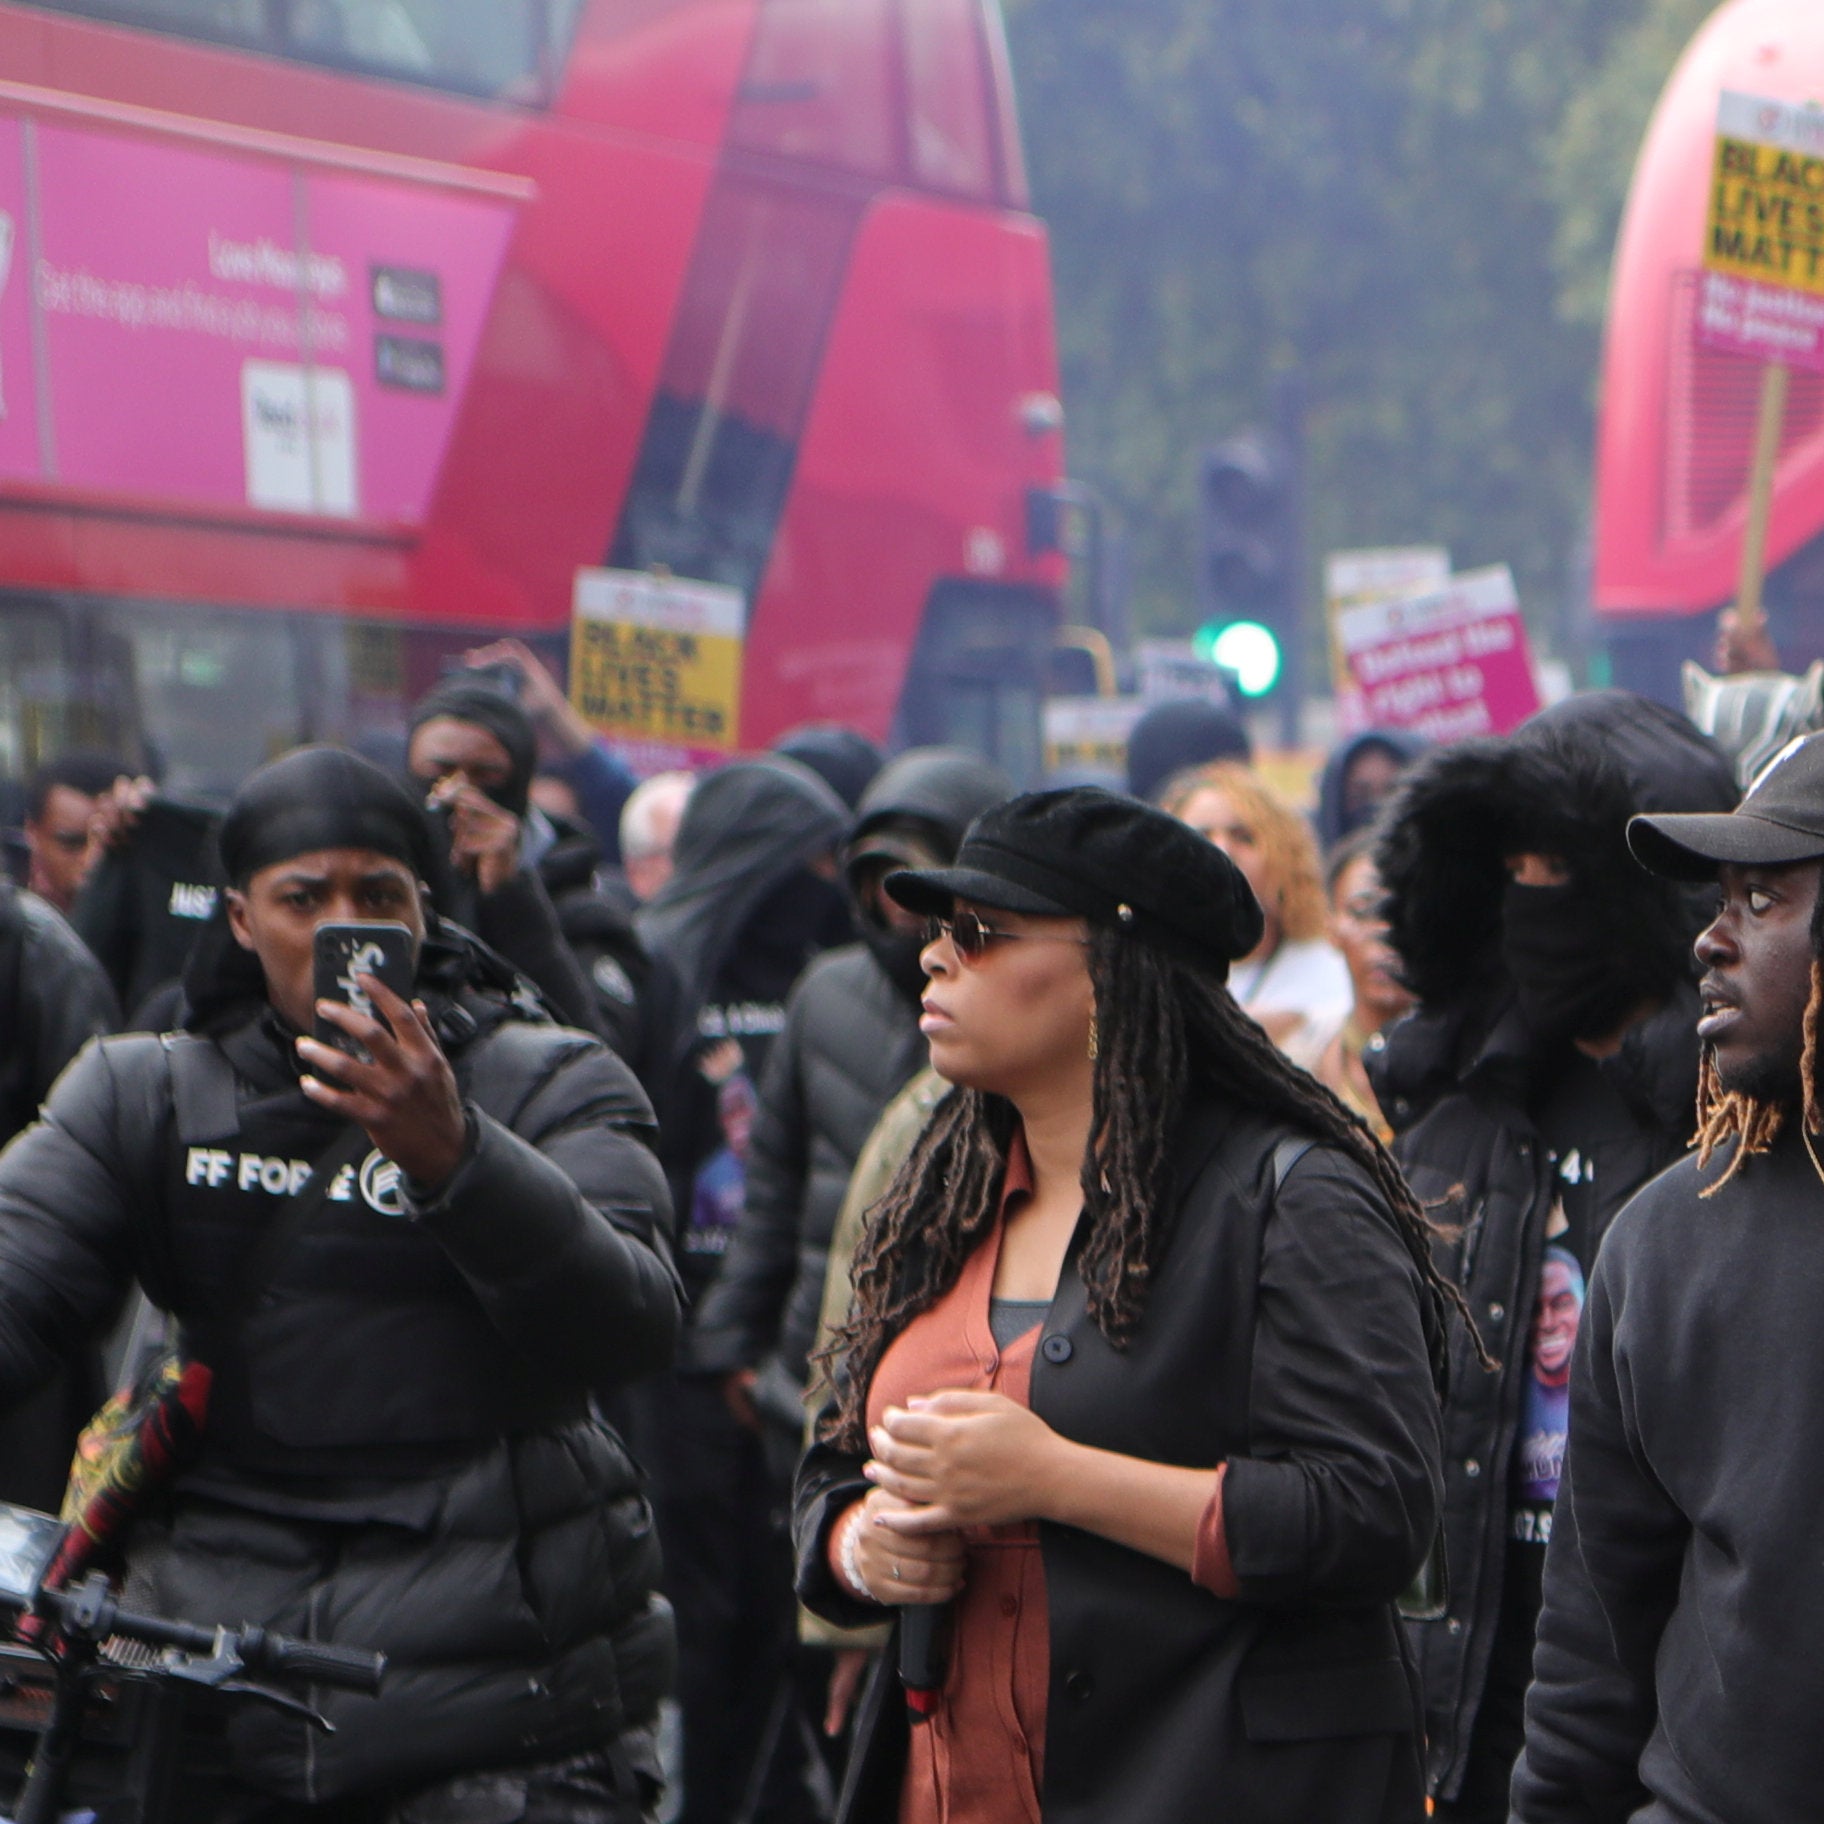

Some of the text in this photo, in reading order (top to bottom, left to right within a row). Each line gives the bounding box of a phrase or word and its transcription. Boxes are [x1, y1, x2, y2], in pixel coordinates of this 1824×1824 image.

[585, 617, 700, 667] BLACK
[581, 654, 679, 707] LIVES
[581, 692, 727, 737] MATTER
[237, 1151, 357, 1202] FORE
